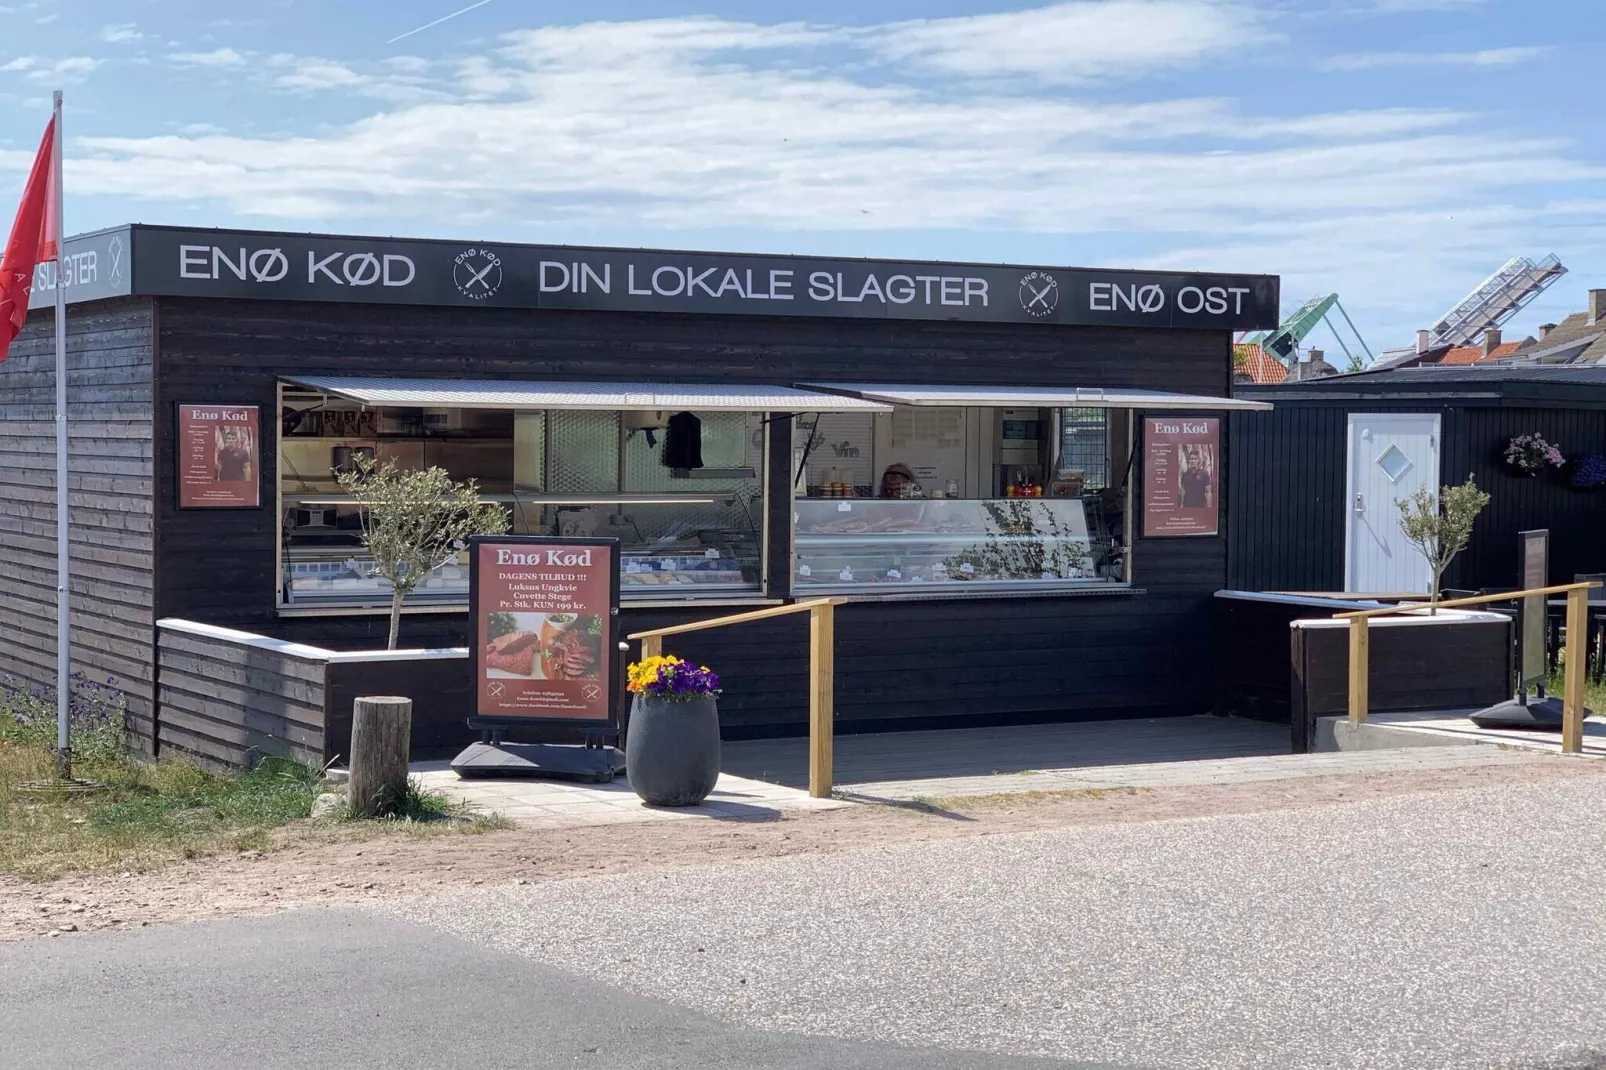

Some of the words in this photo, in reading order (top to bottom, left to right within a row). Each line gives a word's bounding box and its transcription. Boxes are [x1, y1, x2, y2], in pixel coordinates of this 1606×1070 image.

[179, 244, 289, 283] ENØ
[307, 250, 416, 286] KØD
[454, 248, 477, 265] ENØ
[479, 248, 501, 267] KØD
[538, 261, 611, 294] DIN
[627, 264, 794, 300] LOKALE
[807, 272, 988, 306] SLAGTER
[1020, 271, 1038, 286] ENØ
[1040, 271, 1058, 288] KØD
[457, 285, 498, 300] KVALITET
[1089, 282, 1165, 313] ENØ
[1177, 286, 1250, 315] OST
[192, 409, 218, 420] Enø
[222, 410, 248, 421] Kød
[1154, 422, 1180, 434] Enø
[1182, 422, 1209, 434] Kød
[496, 549, 540, 566] Enø
[545, 549, 593, 567] Kød
[539, 573, 575, 581] TILBUD
[508, 583, 540, 591] Luksus
[513, 592, 547, 600] Cuvette
[548, 593, 572, 602] Stege
[500, 600, 513, 608] Pr.
[533, 601, 555, 609] KUN
[556, 602, 572, 610] 199
[573, 602, 587, 610] kr.
